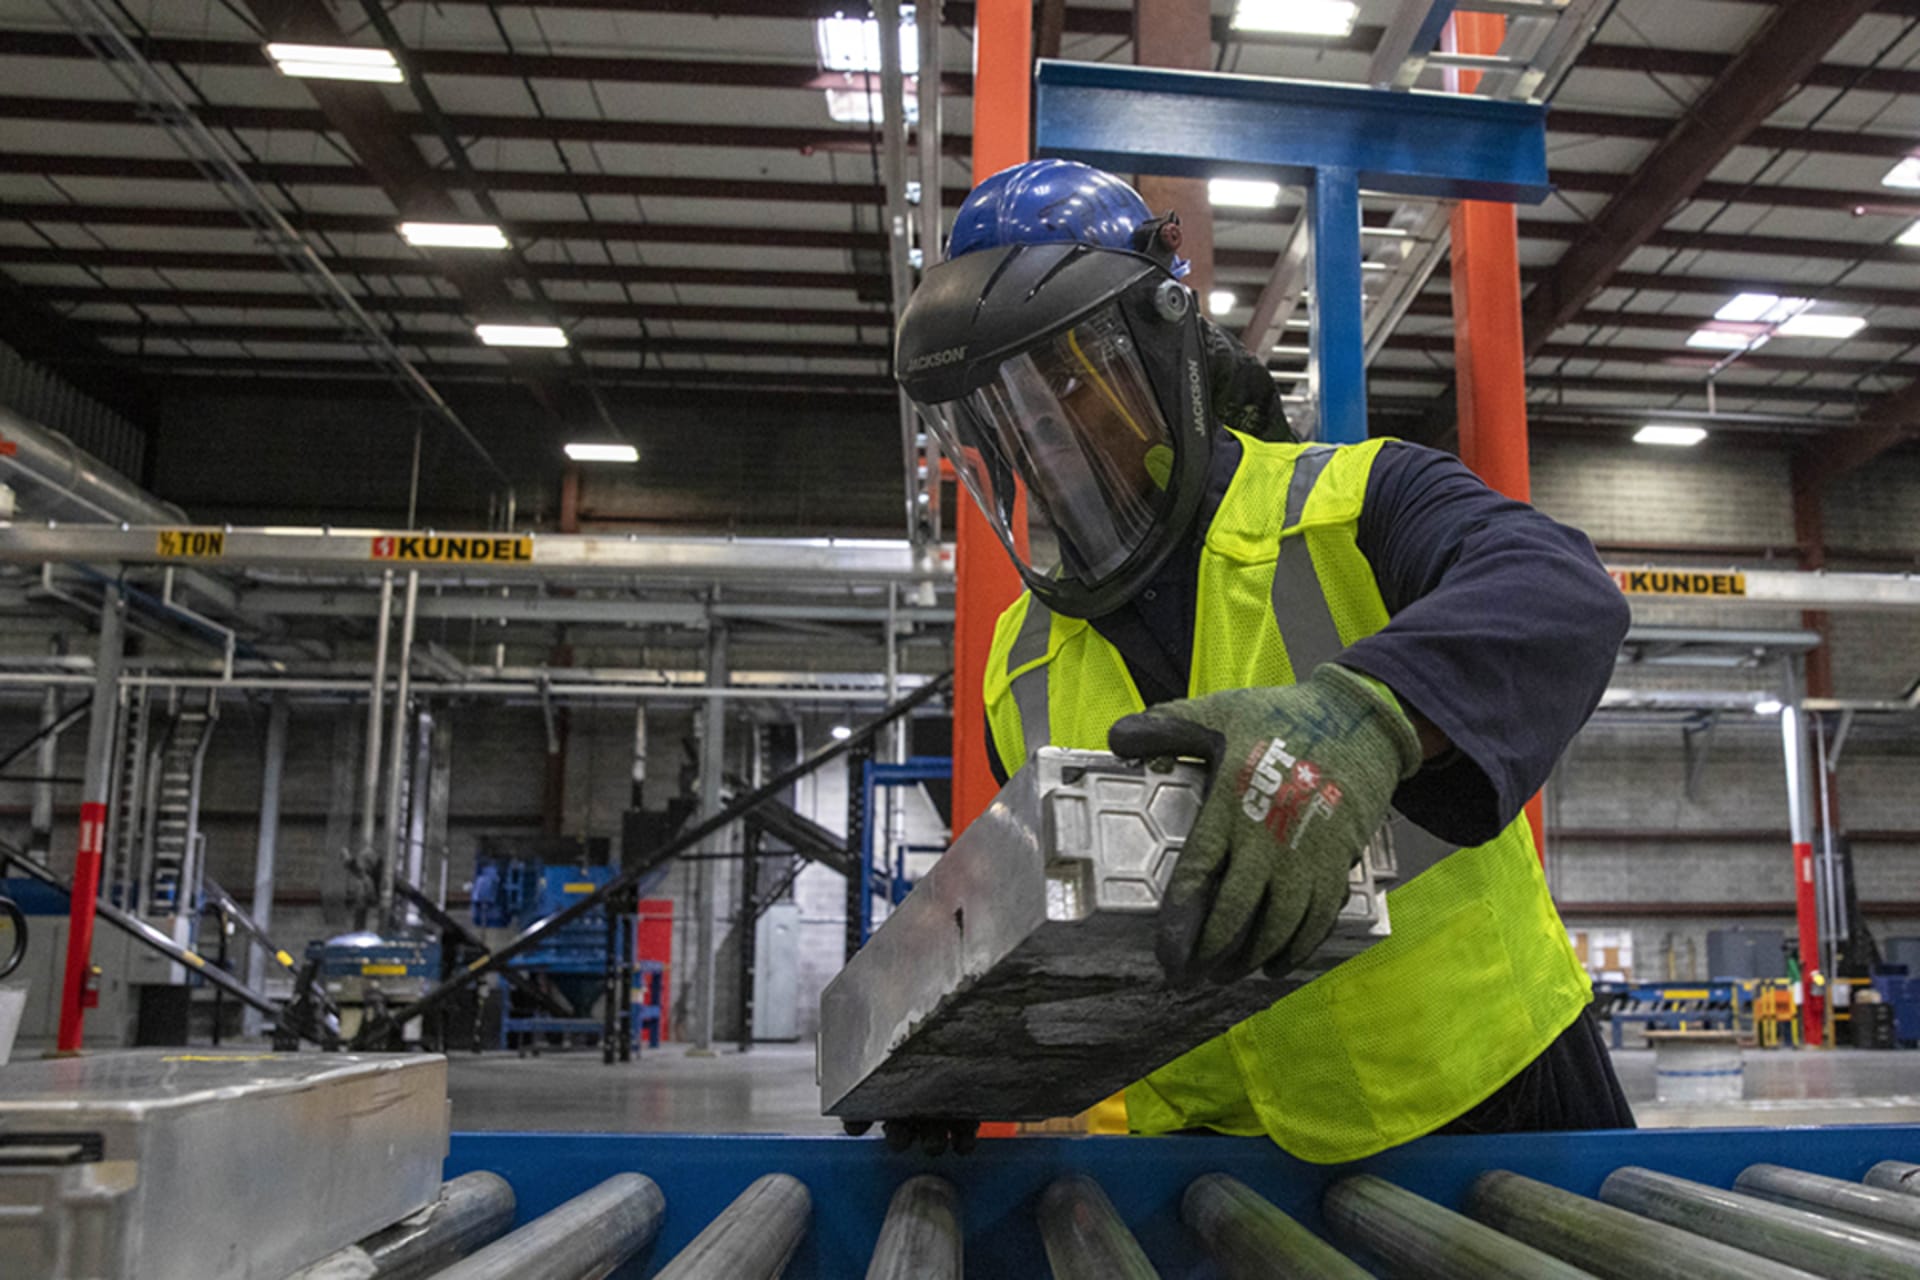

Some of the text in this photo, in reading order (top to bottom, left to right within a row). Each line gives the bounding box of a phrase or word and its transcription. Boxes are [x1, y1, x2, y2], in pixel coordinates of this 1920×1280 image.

[1187, 359, 1206, 437] JACKSON
[180, 531, 223, 555] TON
[399, 536, 531, 560] KUNDEL
[1630, 572, 1745, 595] KUNDEL
[1242, 737, 1296, 822] CUT
